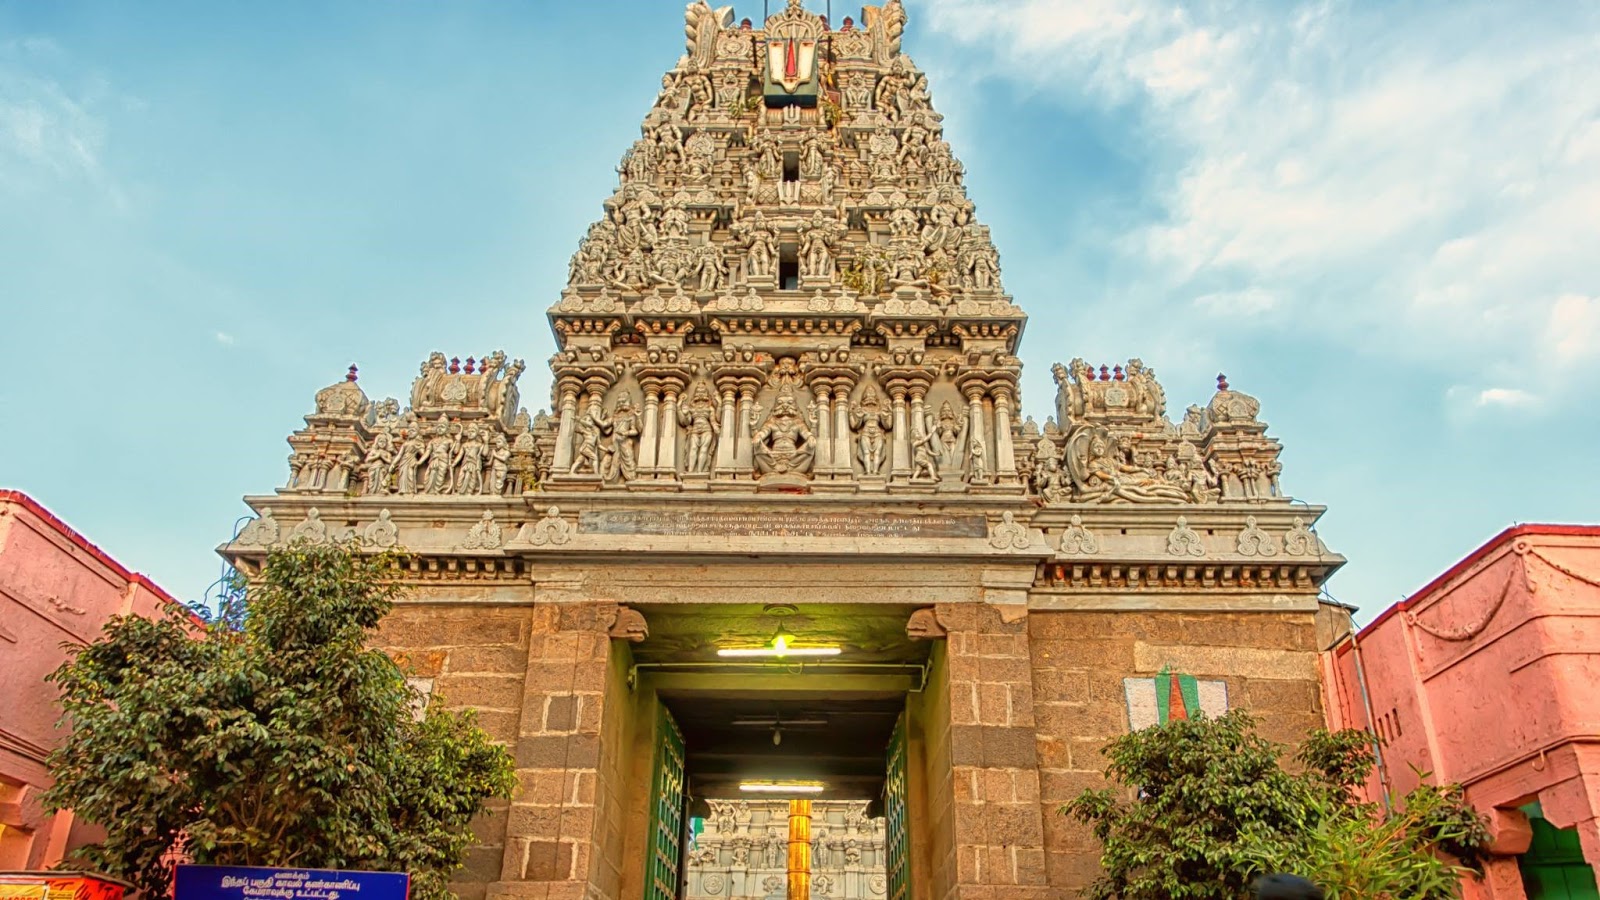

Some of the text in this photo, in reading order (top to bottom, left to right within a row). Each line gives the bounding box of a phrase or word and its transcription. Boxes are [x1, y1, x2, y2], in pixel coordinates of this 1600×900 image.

[250, 876, 274, 889] பகுதி
[275, 878, 303, 888] காவல்
[304, 879, 360, 892] கண்காணிப்பு
